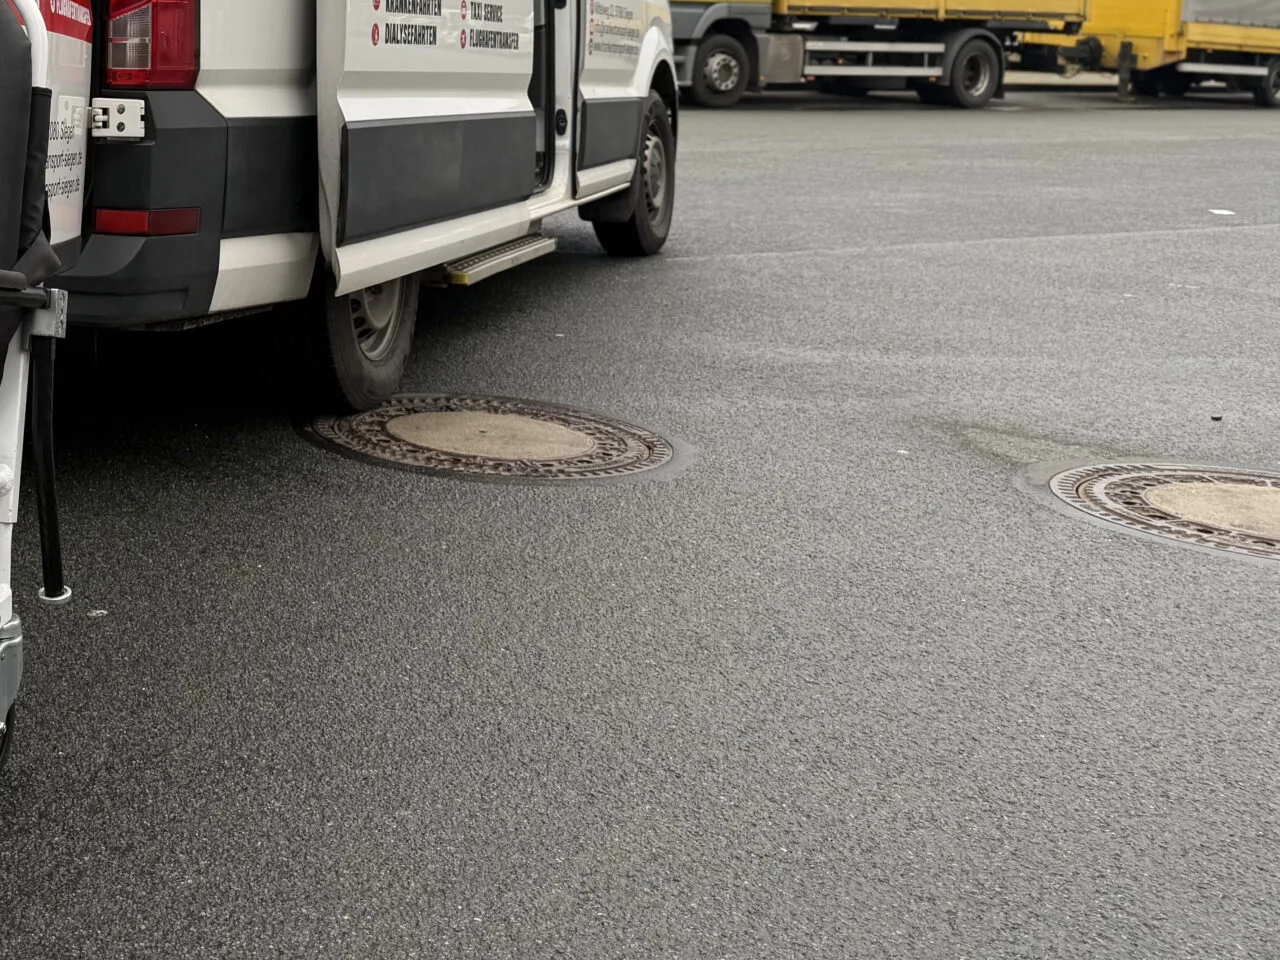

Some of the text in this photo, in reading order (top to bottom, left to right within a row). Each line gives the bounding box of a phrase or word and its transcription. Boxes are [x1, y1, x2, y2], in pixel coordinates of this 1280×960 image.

[470, 1, 503, 23] TAXI SERVICE
[384, 22, 437, 46] DIALYSEFAHRTEN
[469, 28, 519, 50] FLUGHAFENTRANSFER
